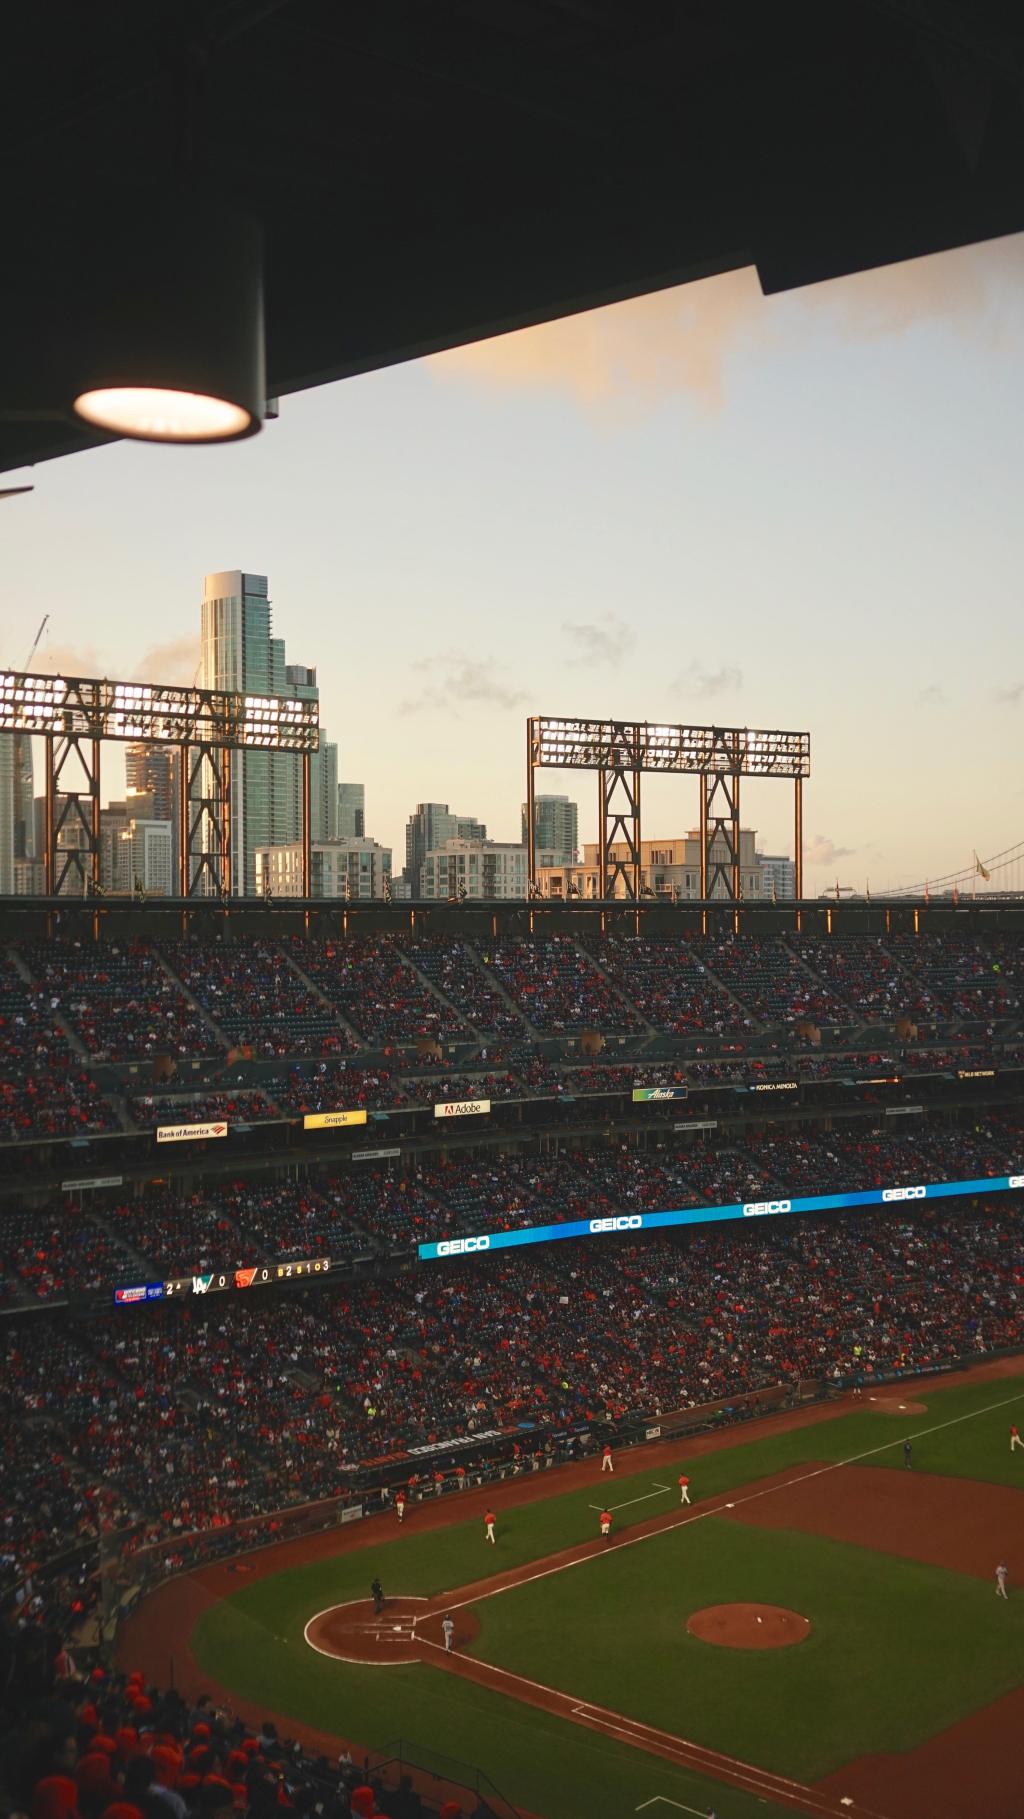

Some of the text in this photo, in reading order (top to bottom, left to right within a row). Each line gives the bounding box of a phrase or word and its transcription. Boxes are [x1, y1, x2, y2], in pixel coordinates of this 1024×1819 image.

[648, 1088, 675, 1099] Alaska
[756, 1081, 798, 1091] KONICA MINOLTA
[455, 1103, 481, 1114] Adobe
[324, 1115, 348, 1125] Snapple
[158, 1127, 209, 1139] Bank of America
[882, 1185, 926, 1202] GEICO
[743, 1200, 791, 1217] GEICO
[589, 1214, 642, 1233] GEICO
[436, 1235, 490, 1257] GEICO
[166, 1283, 173, 1295] 2
[219, 1275, 226, 1287] 0
[262, 1269, 268, 1281] 0
[286, 1265, 292, 1277] 2
[306, 1263, 311, 1274] 1
[323, 1260, 329, 1271] 3
[407, 1429, 502, 1455] SAN FRANCISCO
